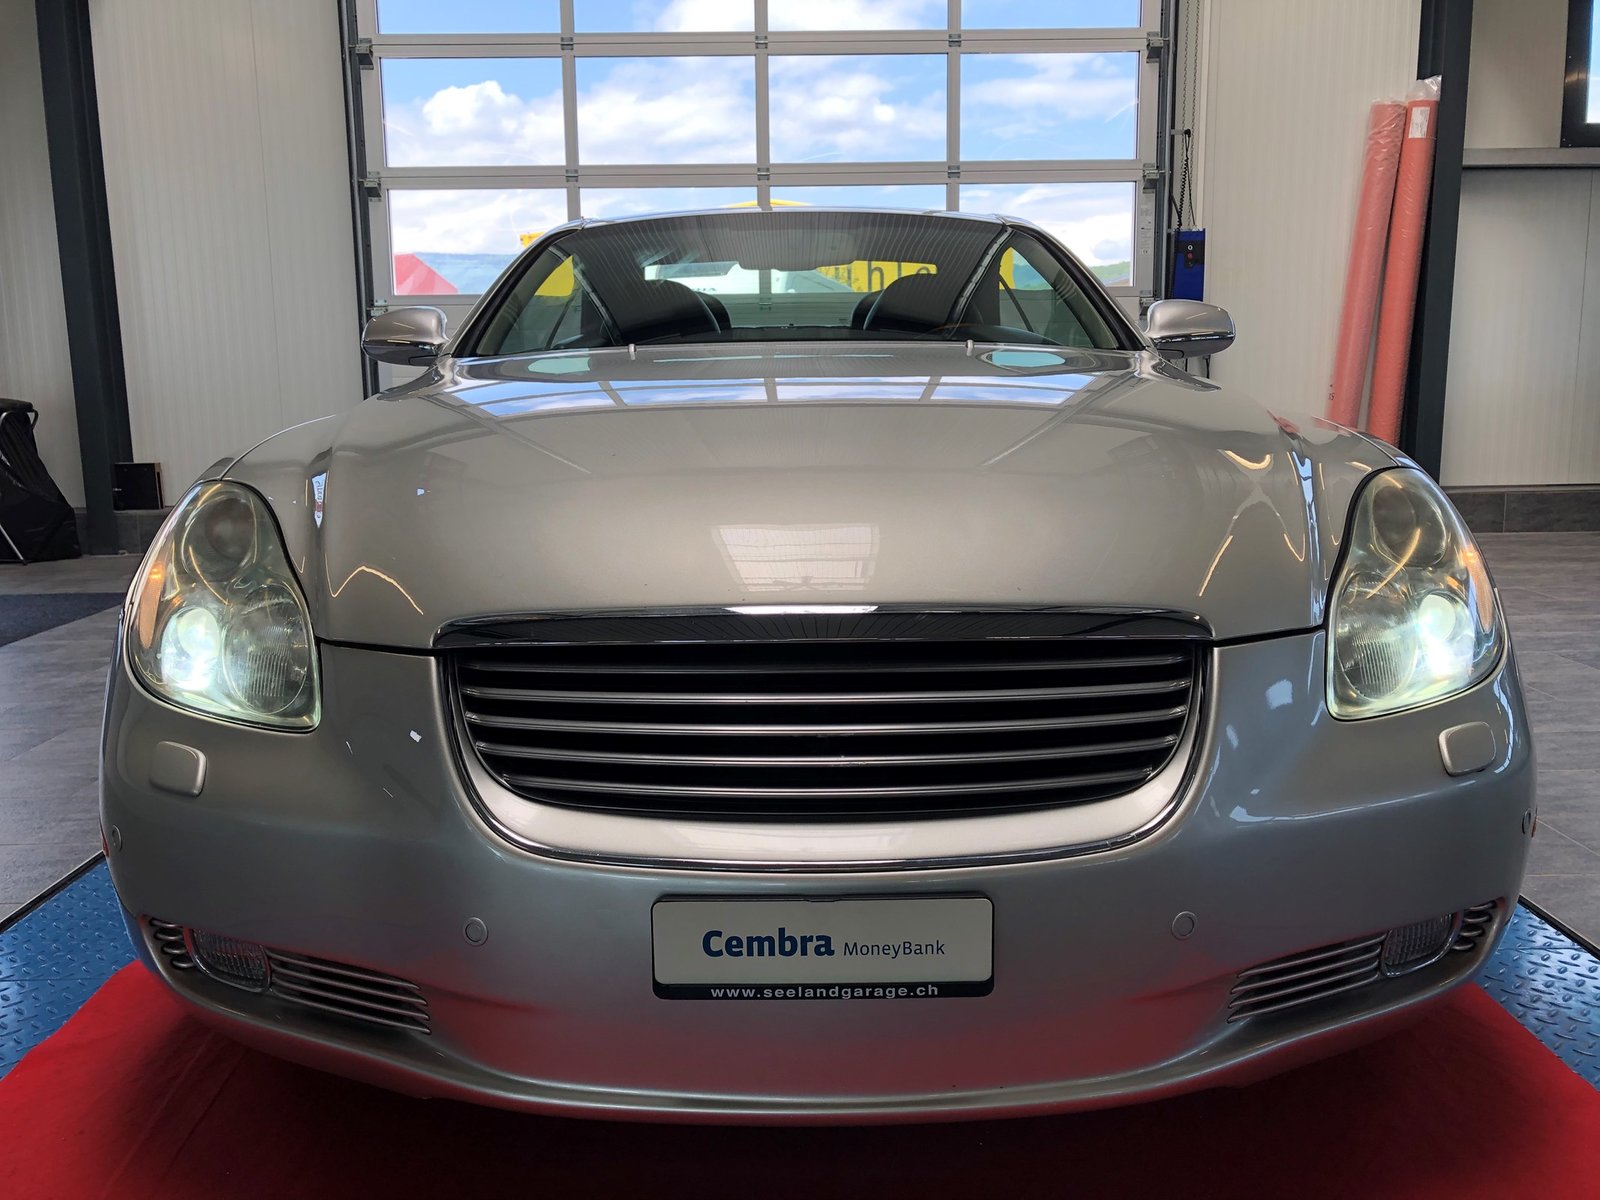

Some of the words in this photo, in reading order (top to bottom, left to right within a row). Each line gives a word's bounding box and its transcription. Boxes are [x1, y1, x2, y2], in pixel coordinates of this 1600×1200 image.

[702, 927, 835, 958] Cembra
[843, 940, 946, 959] MoneyBank
[710, 984, 939, 1000] www.seelandgarage.ch
